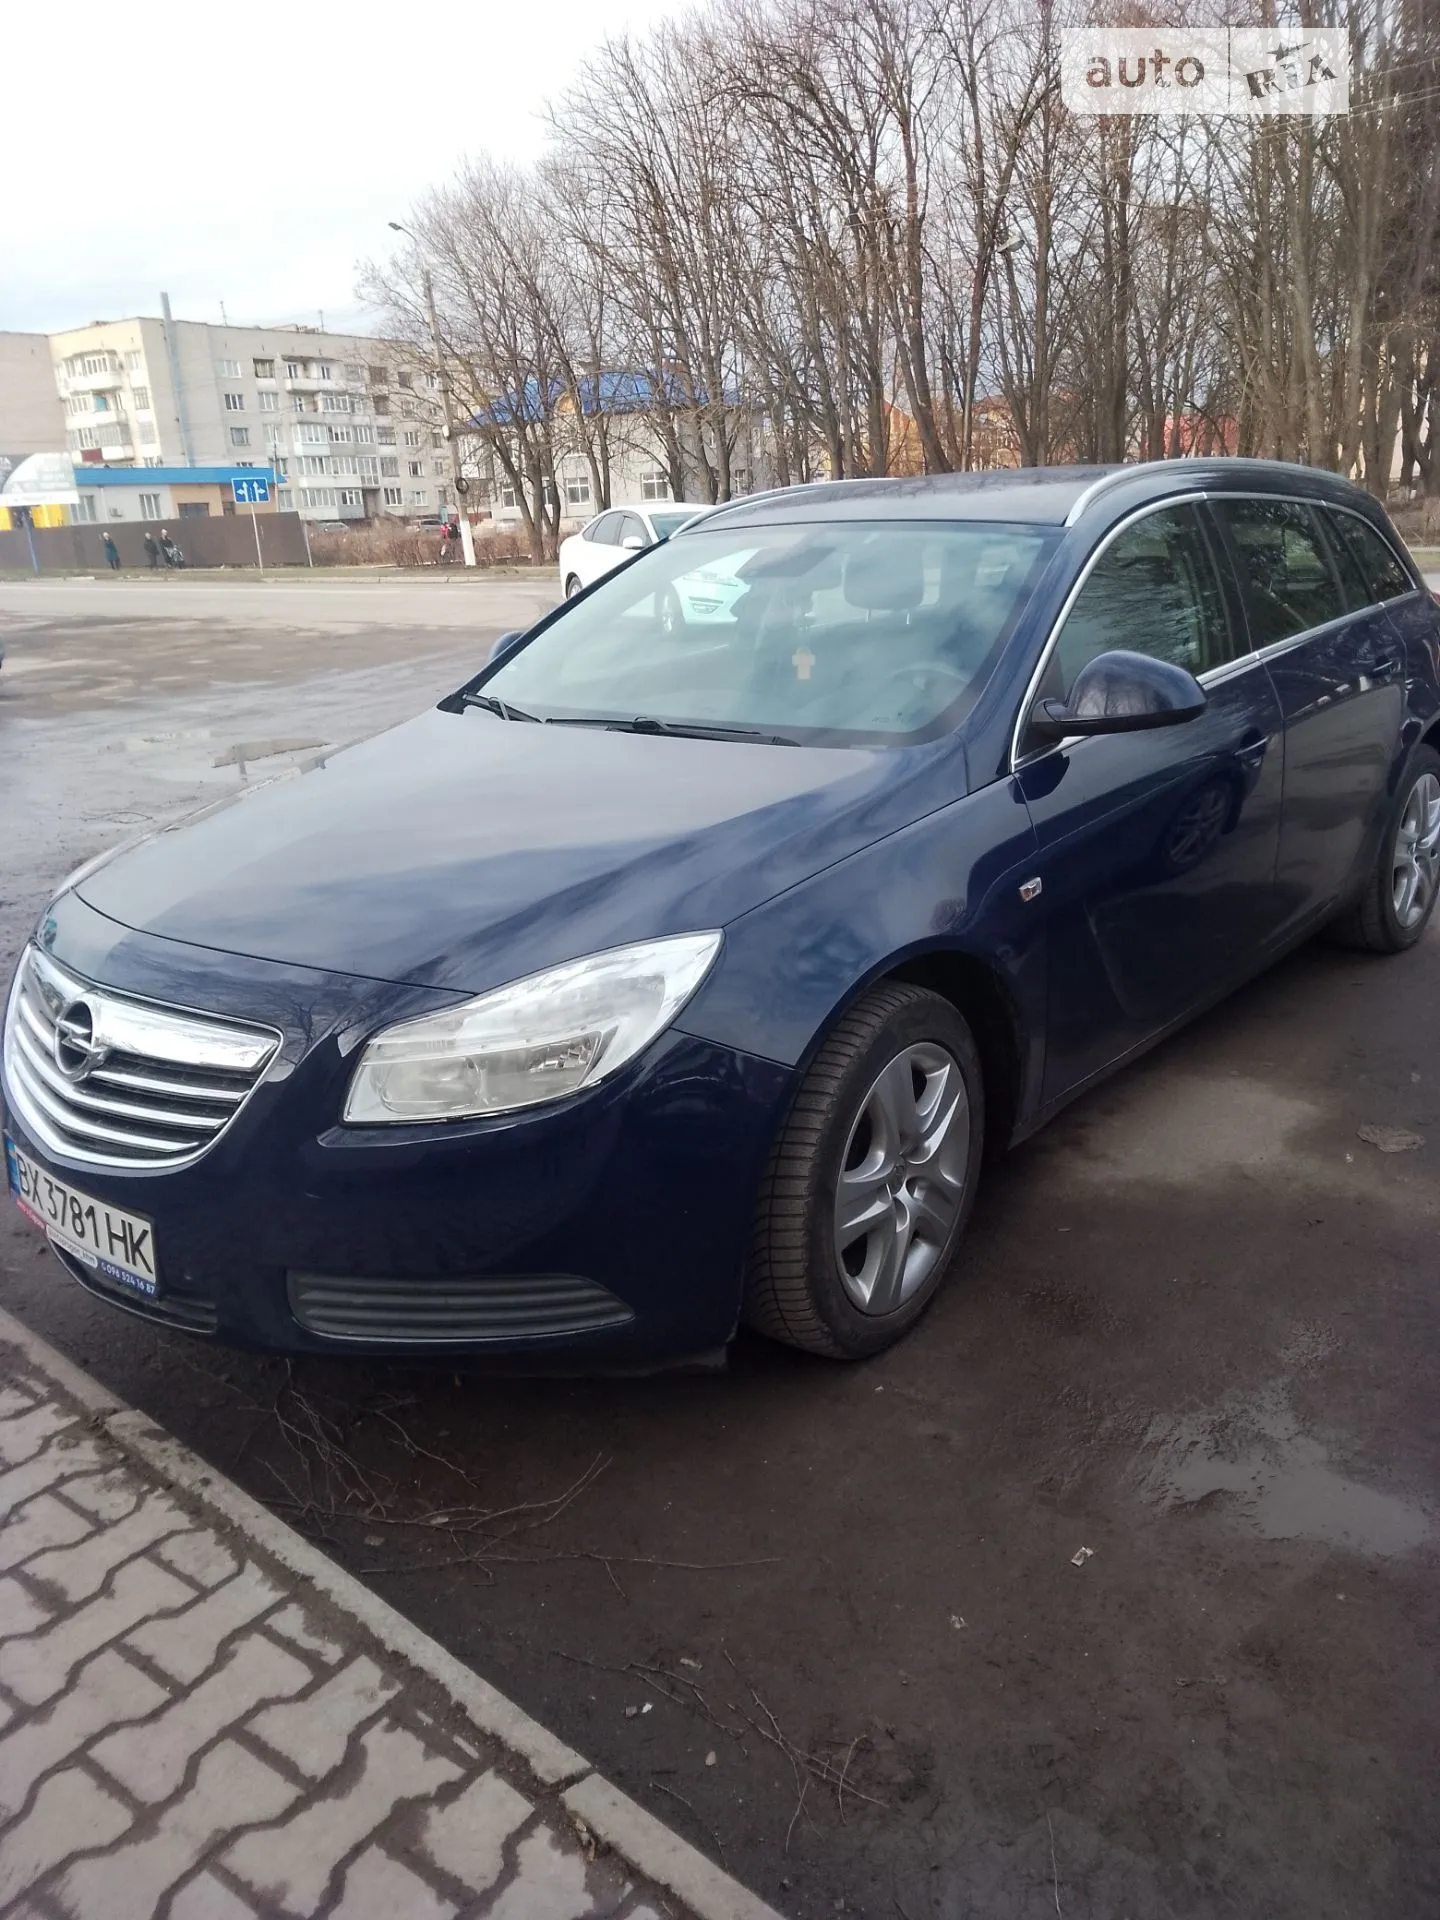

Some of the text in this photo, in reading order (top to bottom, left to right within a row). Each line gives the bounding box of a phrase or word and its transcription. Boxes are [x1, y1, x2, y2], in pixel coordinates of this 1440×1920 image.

[17, 1152, 43, 1211] BX
[43, 1176, 99, 1249] 3781
[104, 1212, 153, 1274] HK
